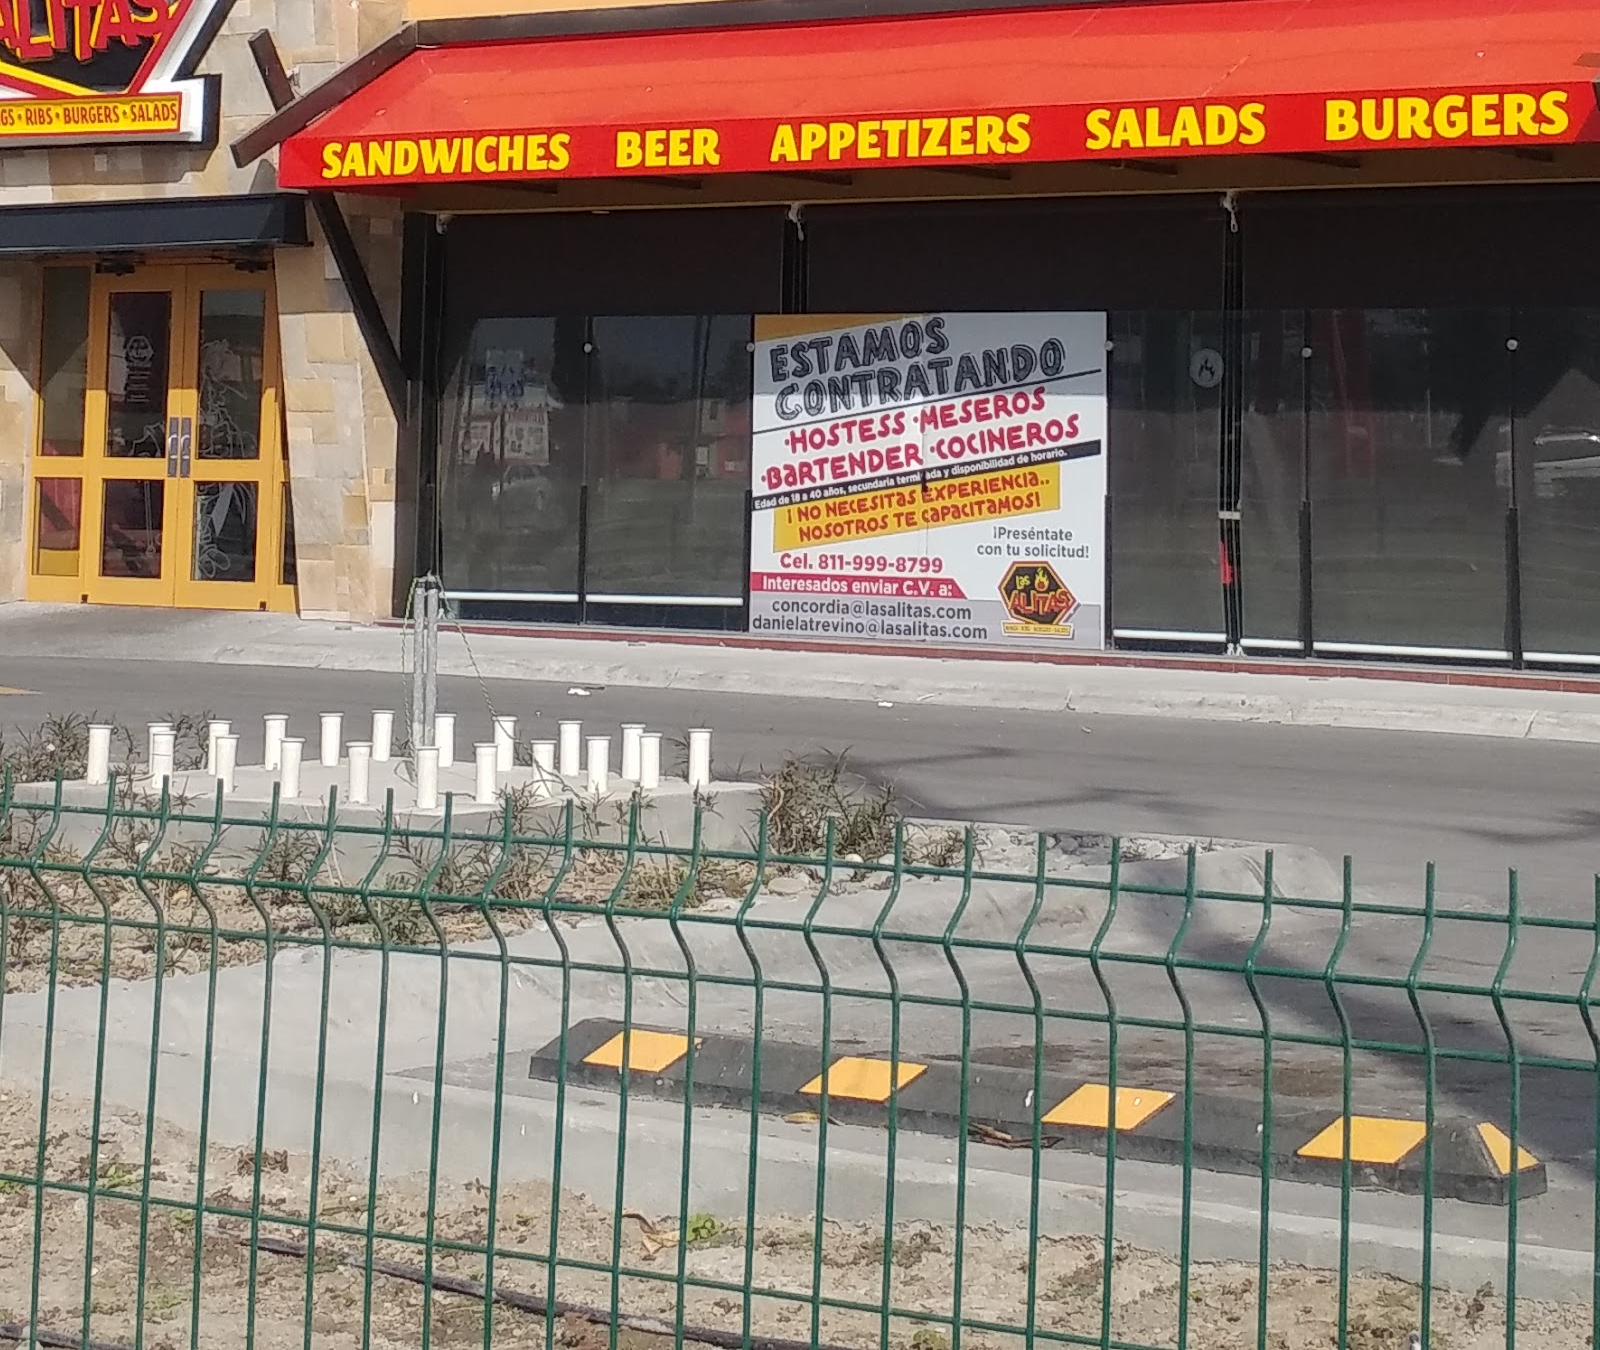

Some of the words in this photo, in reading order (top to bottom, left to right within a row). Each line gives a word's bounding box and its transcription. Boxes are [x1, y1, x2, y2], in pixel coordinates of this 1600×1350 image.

[24, 105, 53, 125] RIBS
[63, 104, 120, 125] BURGERS
[130, 103, 178, 123] SALADS
[322, 132, 571, 180] SANDWICHES
[615, 128, 721, 169] BEER
[769, 112, 1032, 163] APPETIZERS
[1084, 102, 1267, 151] SALADS
[1324, 90, 1570, 142] BURGERS
[769, 317, 950, 382] ESTAMOS
[775, 337, 1067, 421] CONTRATANDO
[789, 411, 906, 454] HOSTESS
[919, 387, 1046, 434] MESEROS
[936, 414, 1080, 460] COCINEROS
[754, 497, 778, 510] Edad
[778, 495, 790, 505] de
[790, 493, 801, 504] 18
[809, 489, 823, 499] 40
[823, 484, 847, 498] años,
[848, 476, 896, 494] secundaria
[896, 469, 943, 486] termiada
[943, 468, 950, 479] y
[951, 455, 1016, 476] disponibilidad
[1017, 453, 1030, 464] de
[1030, 447, 1068, 463] horario.
[798, 514, 889, 542] NOSOTROS
[892, 511, 918, 528] TE
[780, 553, 813, 570] Cel.
[818, 555, 944, 574] 811-999-8799
[977, 544, 1002, 556] con
[1005, 543, 1021, 556] tu
[1024, 541, 1090, 559] solicitud!
[762, 576, 848, 595] Interesados
[852, 579, 900, 596] enviar
[903, 582, 936, 597] C.V.
[939, 584, 953, 597] a:
[771, 599, 972, 621] concordia@lasalitas.com
[1008, 589, 1074, 617] ALITAS
[752, 615, 988, 640] danielatrevino@lasalitas.com
